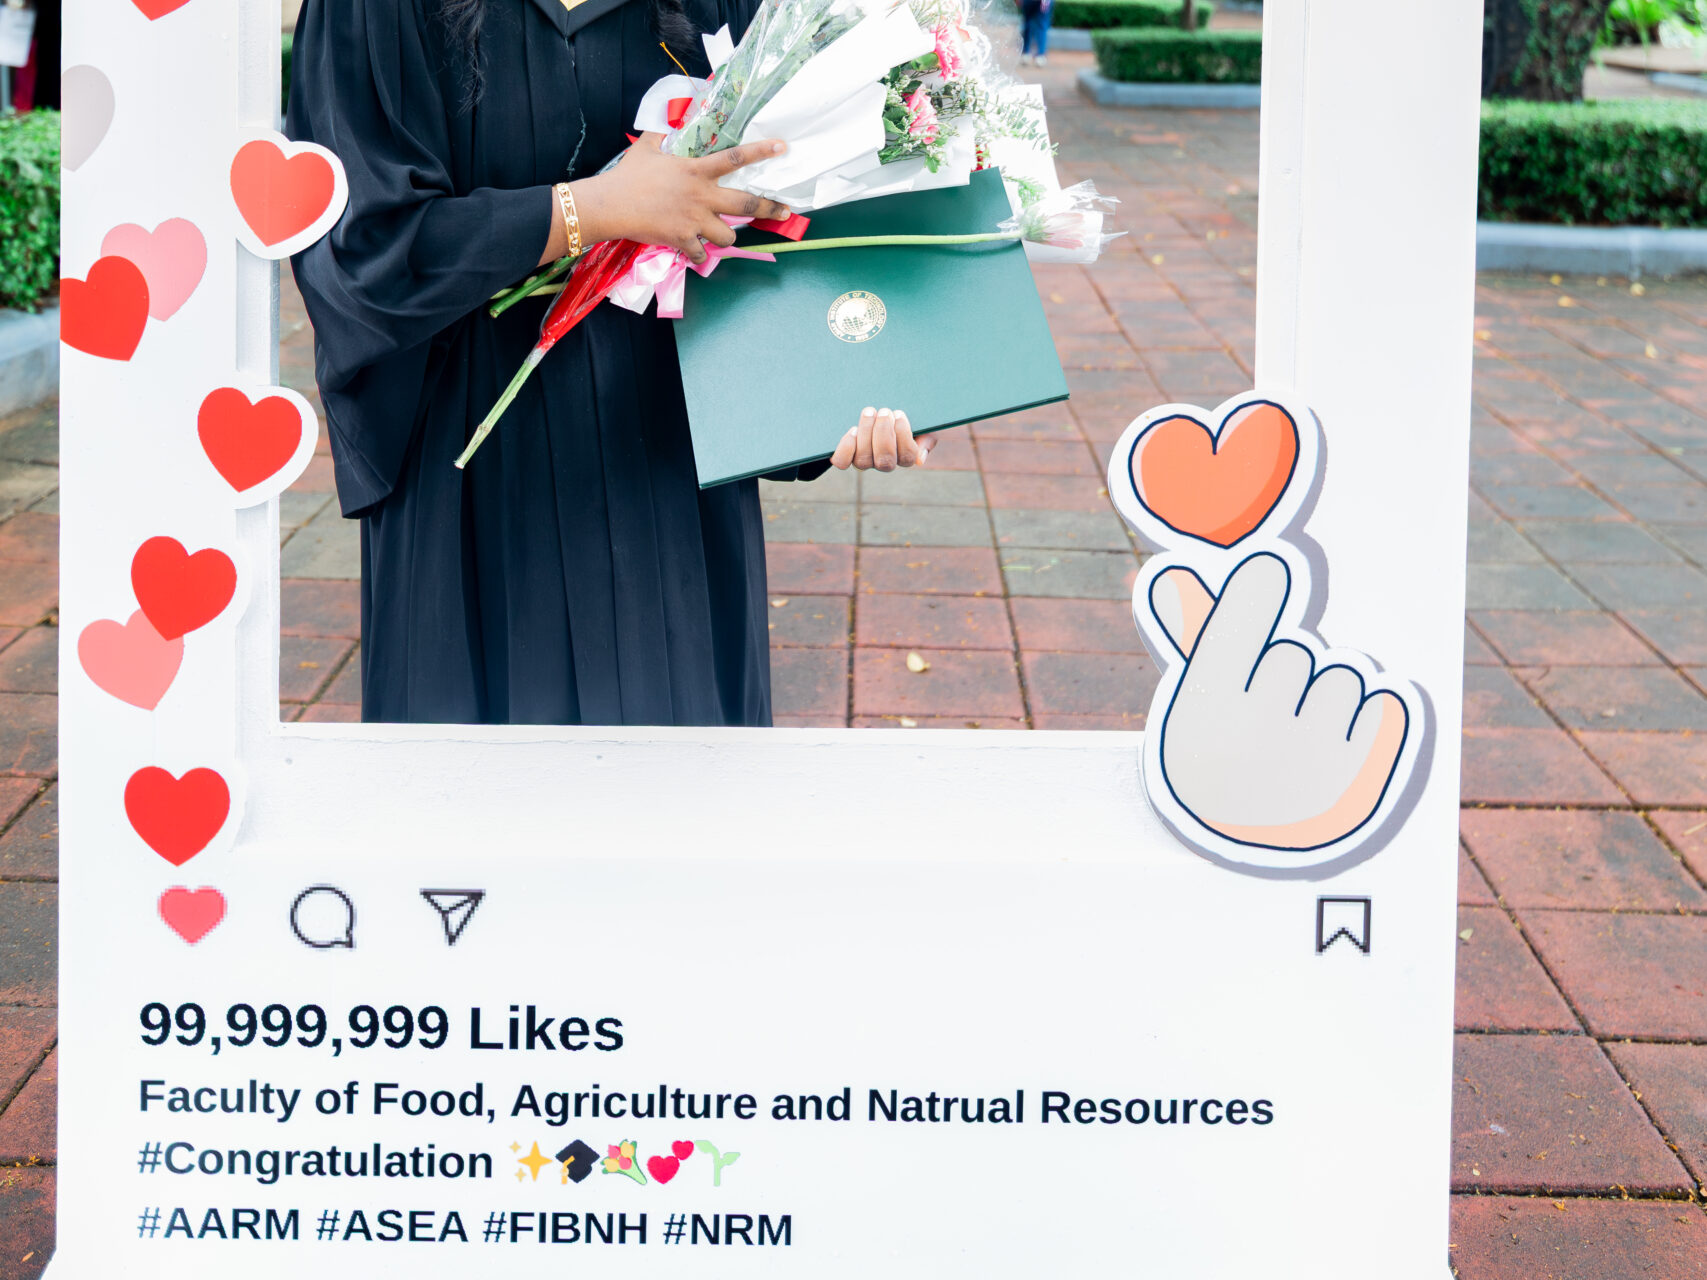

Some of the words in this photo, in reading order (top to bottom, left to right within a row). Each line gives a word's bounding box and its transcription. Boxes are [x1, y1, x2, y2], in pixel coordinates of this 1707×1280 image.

[139, 1001, 449, 1058] 99,999,999
[470, 1004, 625, 1052] Likes
[139, 1079, 302, 1123] Faculty
[315, 1080, 360, 1116] of
[373, 1083, 496, 1124] Food,
[510, 1083, 758, 1127] Agriculture
[771, 1086, 852, 1122] and
[868, 1088, 1025, 1124] Natrual
[1041, 1090, 1275, 1126] Resources
[137, 1141, 493, 1186] #Congratulation
[137, 1206, 300, 1241] #AARM
[315, 1208, 470, 1243] #ASEA
[481, 1210, 648, 1245] #FIBNH
[662, 1212, 793, 1247] #NRM
